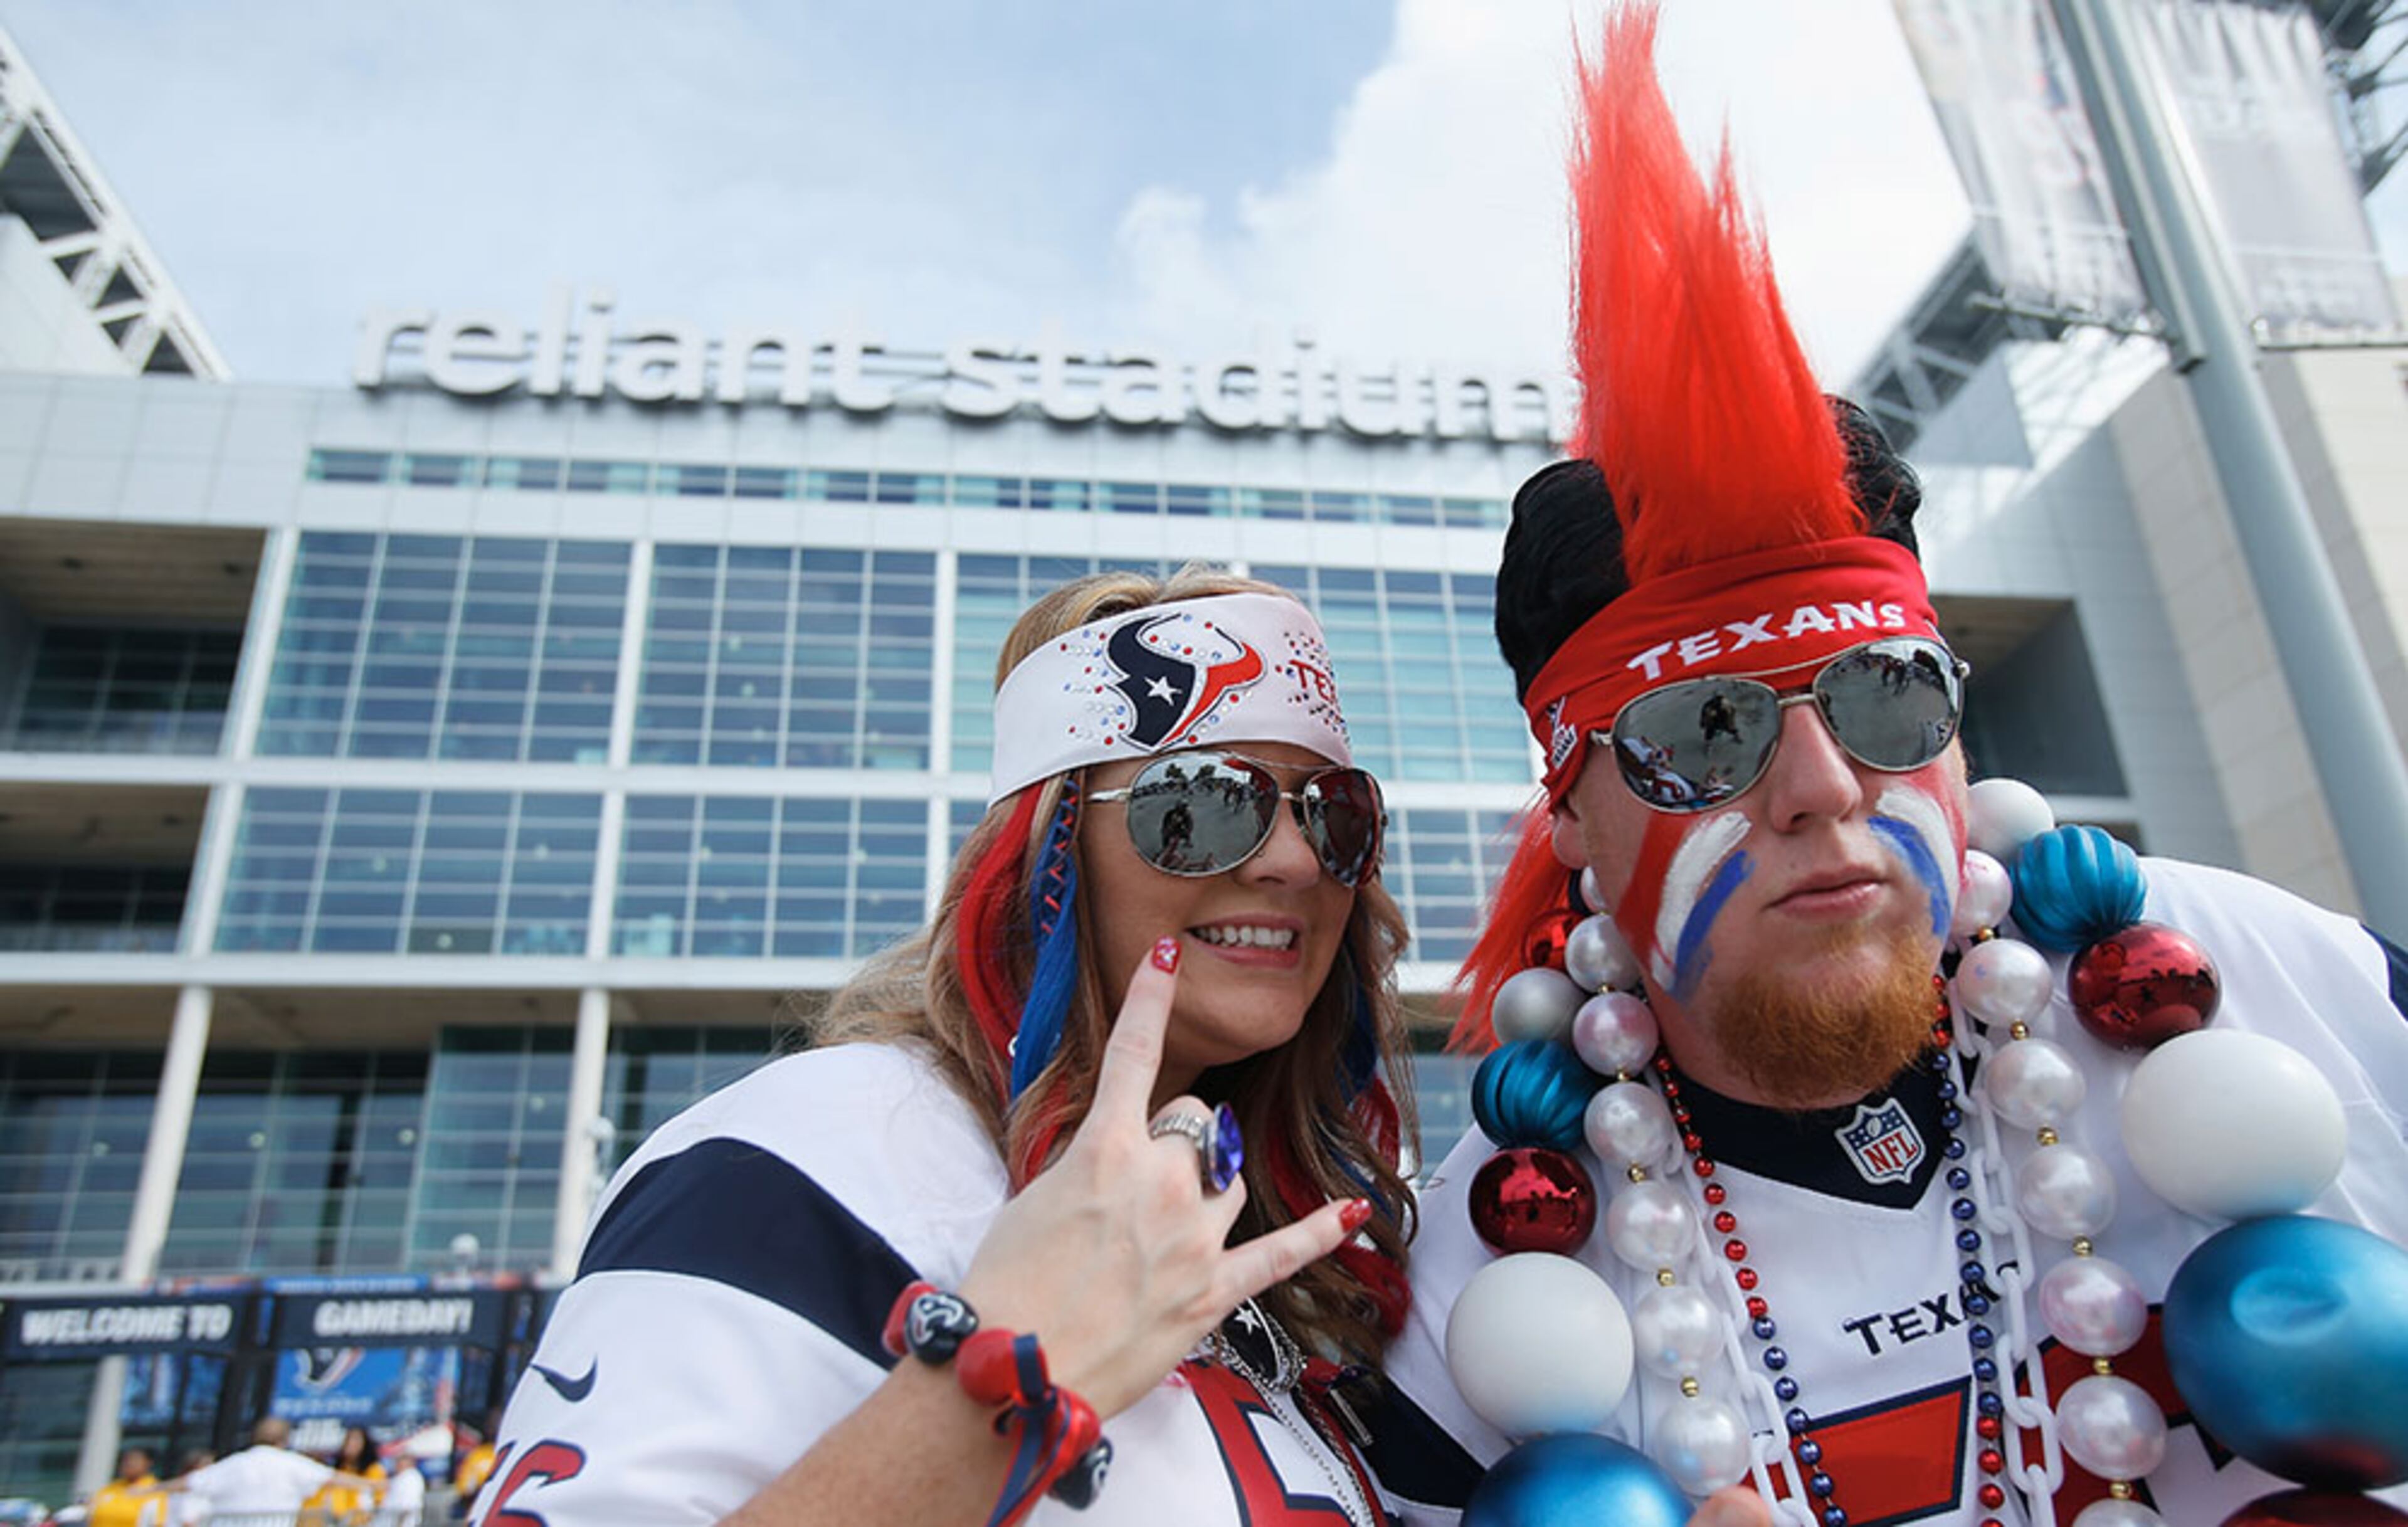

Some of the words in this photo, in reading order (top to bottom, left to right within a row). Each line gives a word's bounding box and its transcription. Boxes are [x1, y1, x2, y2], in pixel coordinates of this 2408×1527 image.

[352, 283, 894, 414] reliant
[943, 320, 1579, 443] stadium
[1626, 600, 1906, 681] TEXANS
[1863, 1132, 1918, 1173] NFL
[21, 1306, 186, 1346] WELCOME
[189, 1304, 233, 1341] TO
[314, 1297, 473, 1337] GAMEDAY!
